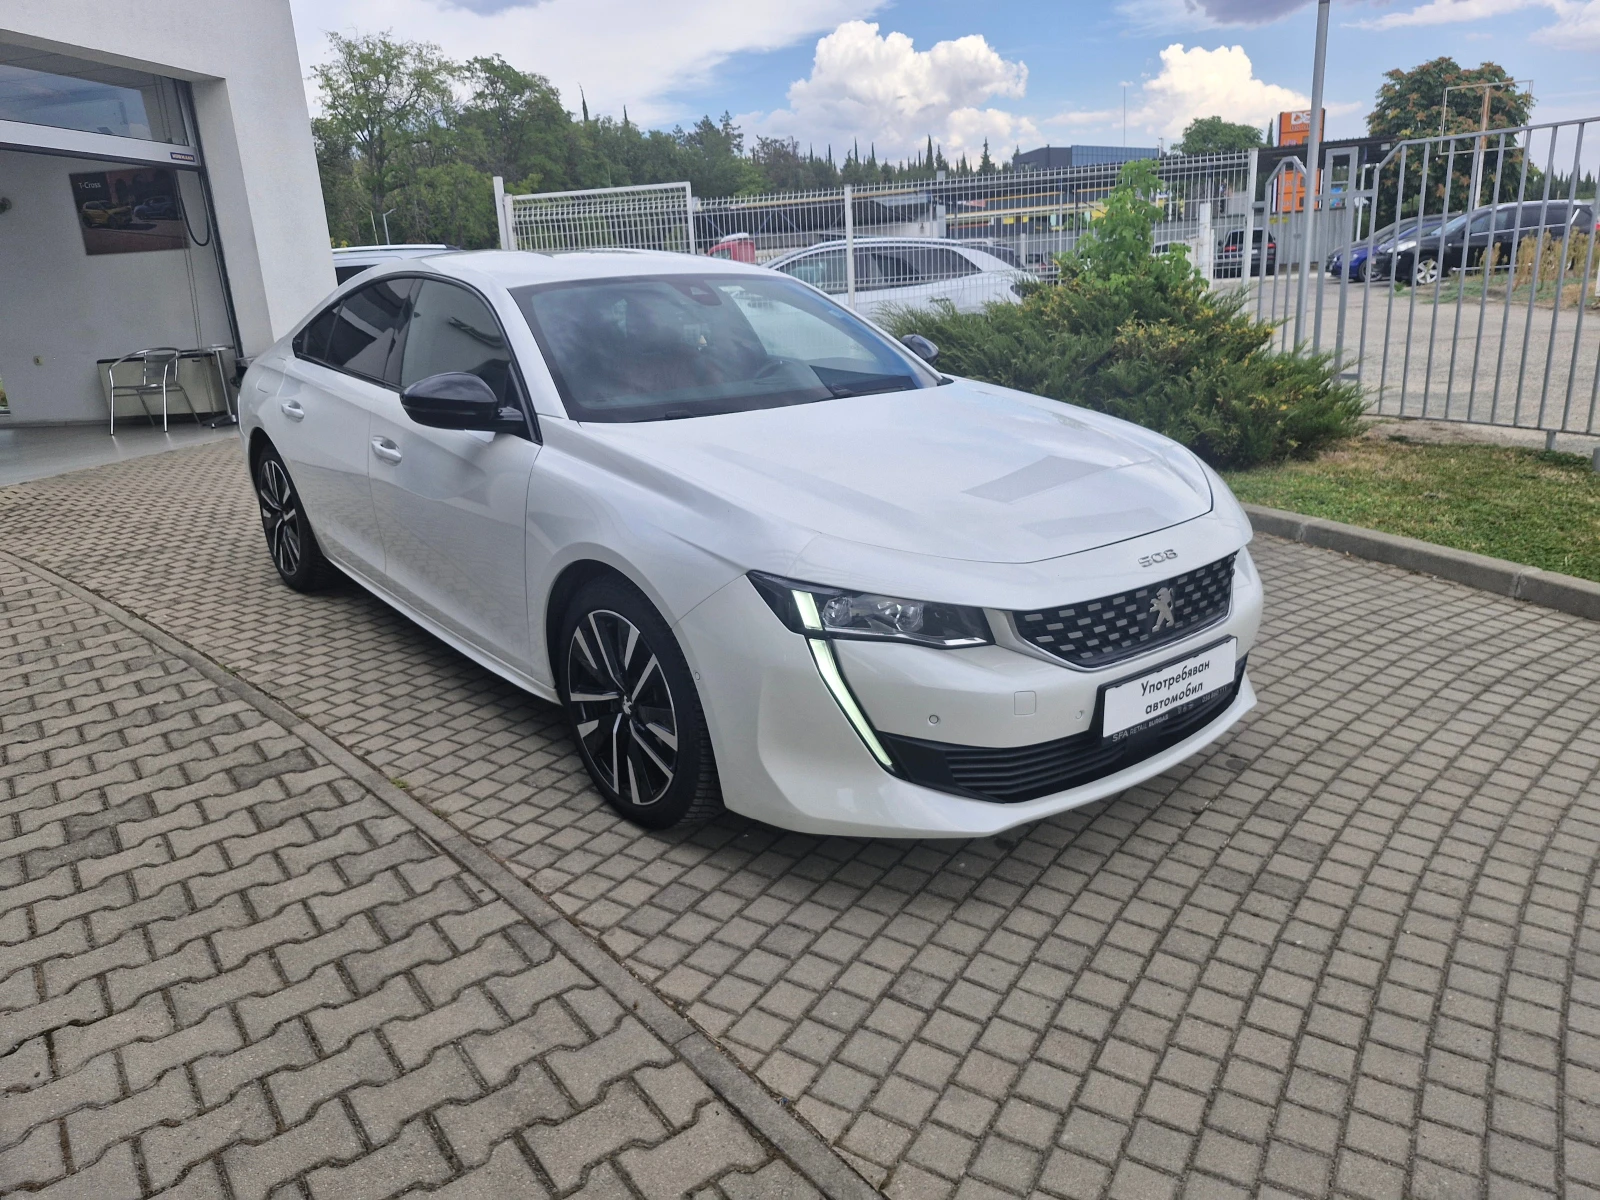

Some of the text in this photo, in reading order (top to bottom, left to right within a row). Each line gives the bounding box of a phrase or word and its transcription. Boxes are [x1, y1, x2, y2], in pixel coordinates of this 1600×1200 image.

[78, 181, 101, 189] T-Cross
[1138, 549, 1178, 568] 508
[1141, 660, 1210, 697] Употребяван
[1145, 682, 1203, 715] автомобил
[1130, 723, 1148, 736] RETAIL
